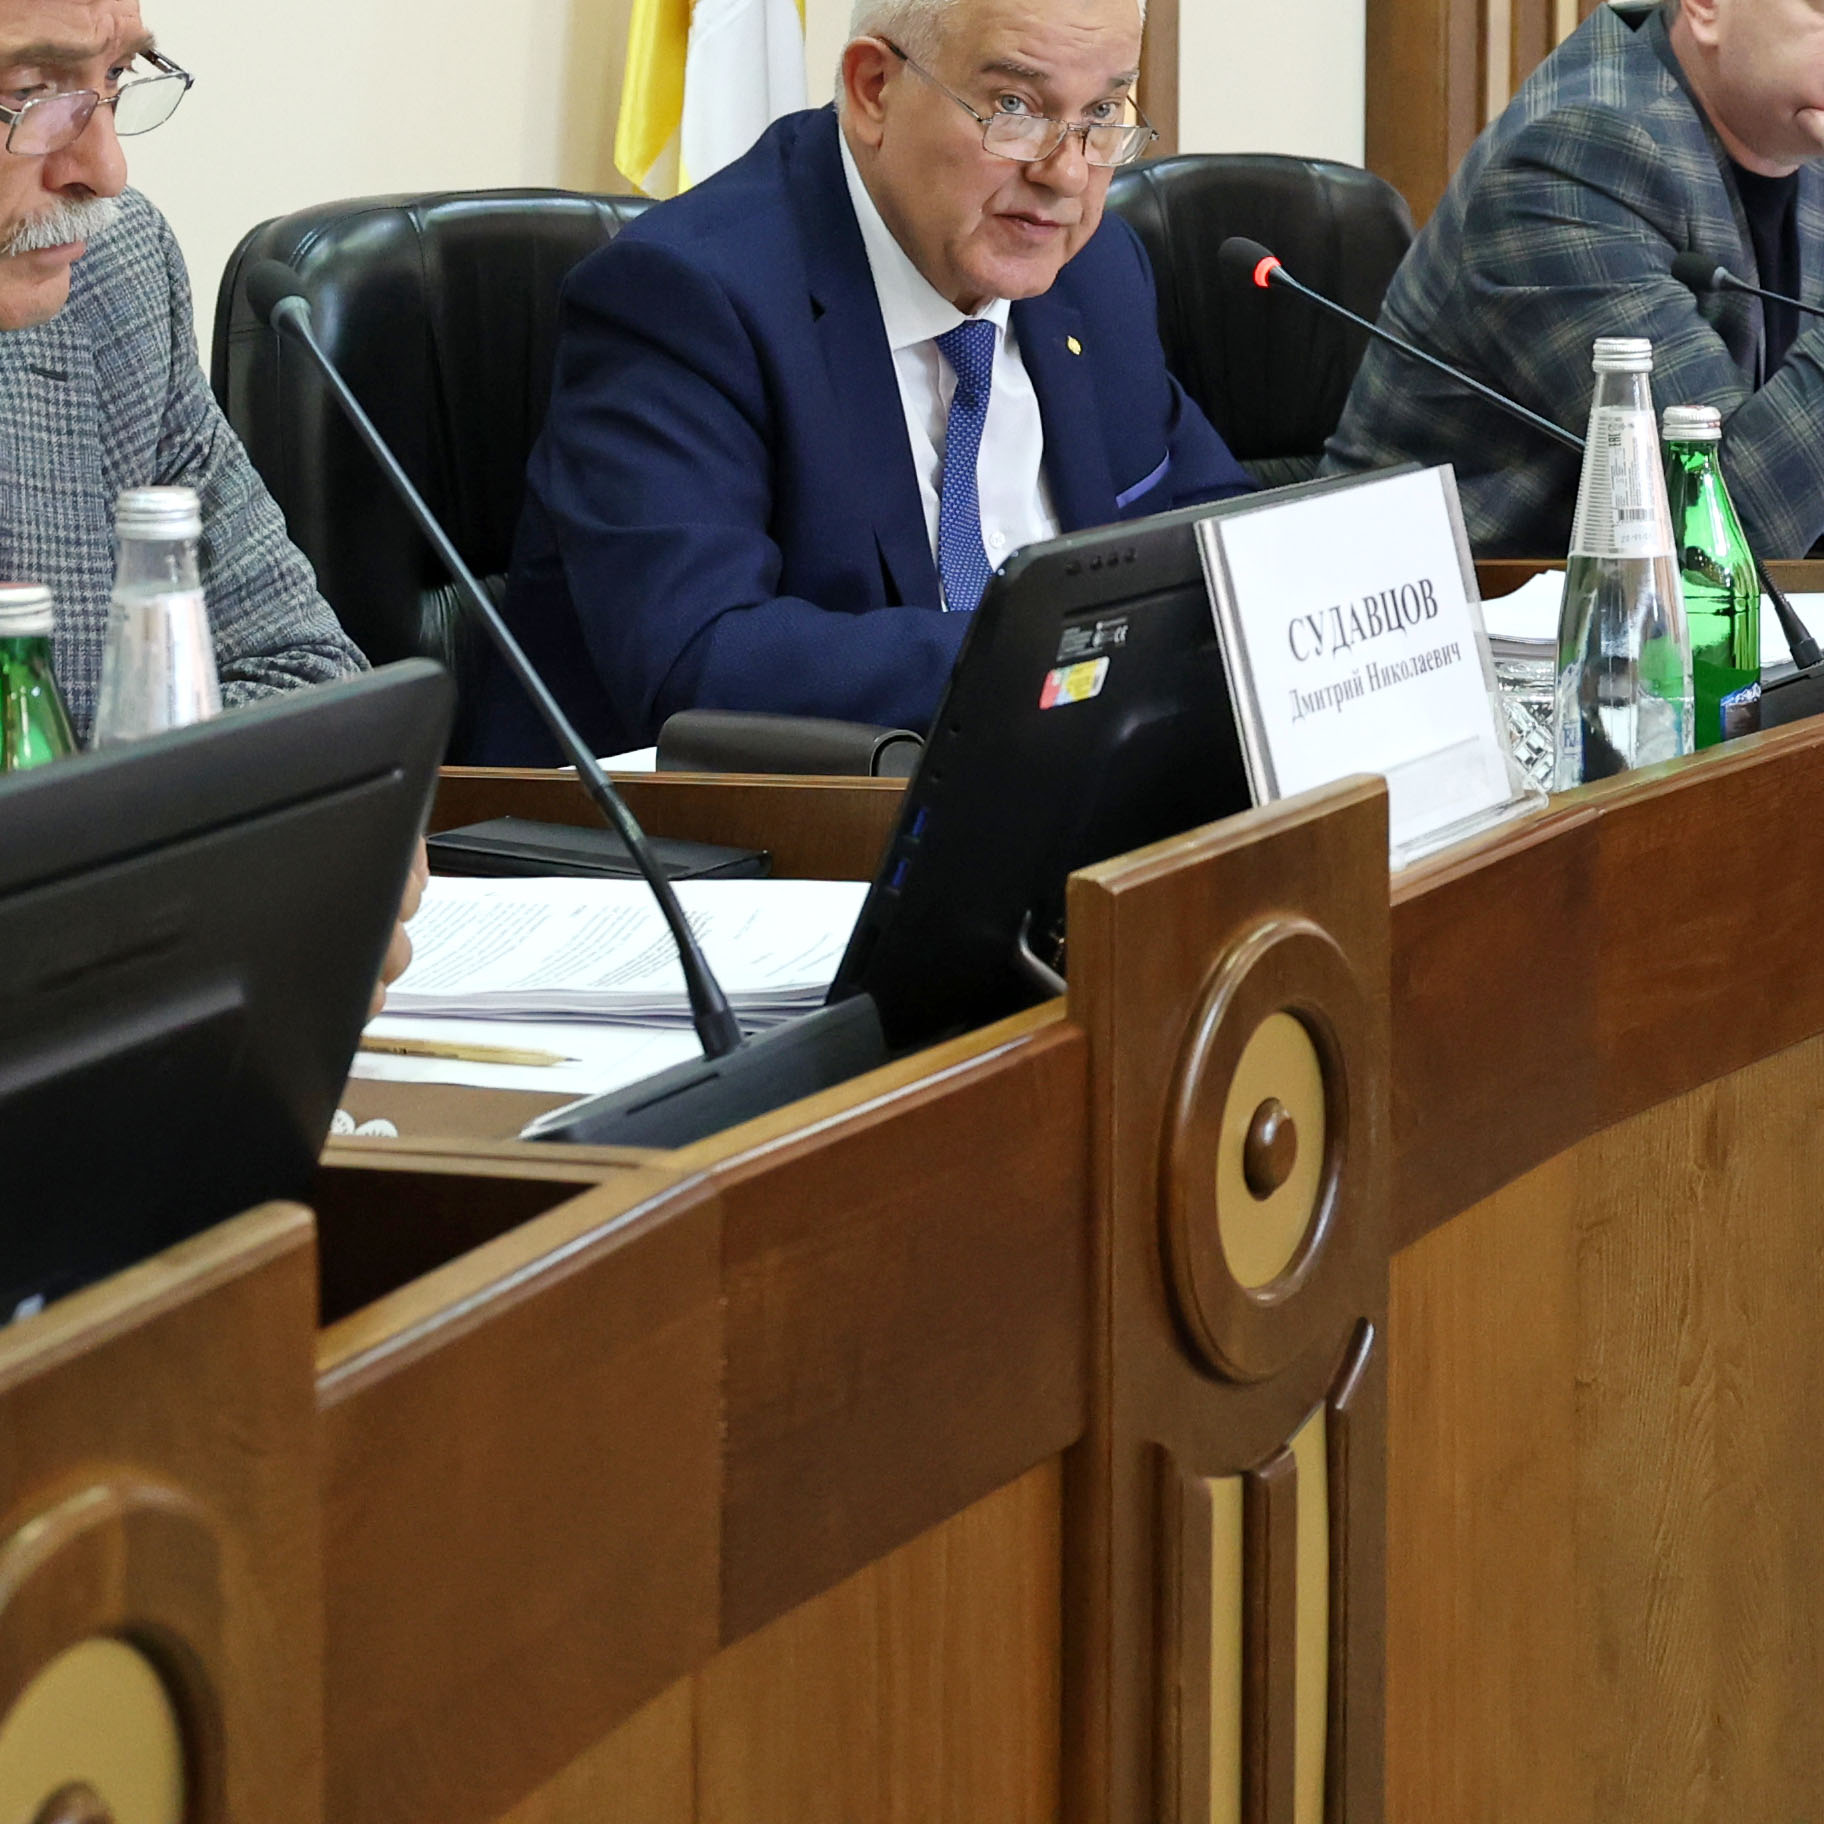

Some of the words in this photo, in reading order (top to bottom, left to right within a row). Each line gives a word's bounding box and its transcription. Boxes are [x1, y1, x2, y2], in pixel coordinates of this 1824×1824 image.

[1288, 578, 1439, 662] СУДАВЦОВ
[1288, 668, 1365, 724] Дмитрий
[1366, 641, 1462, 693] Николаевич
